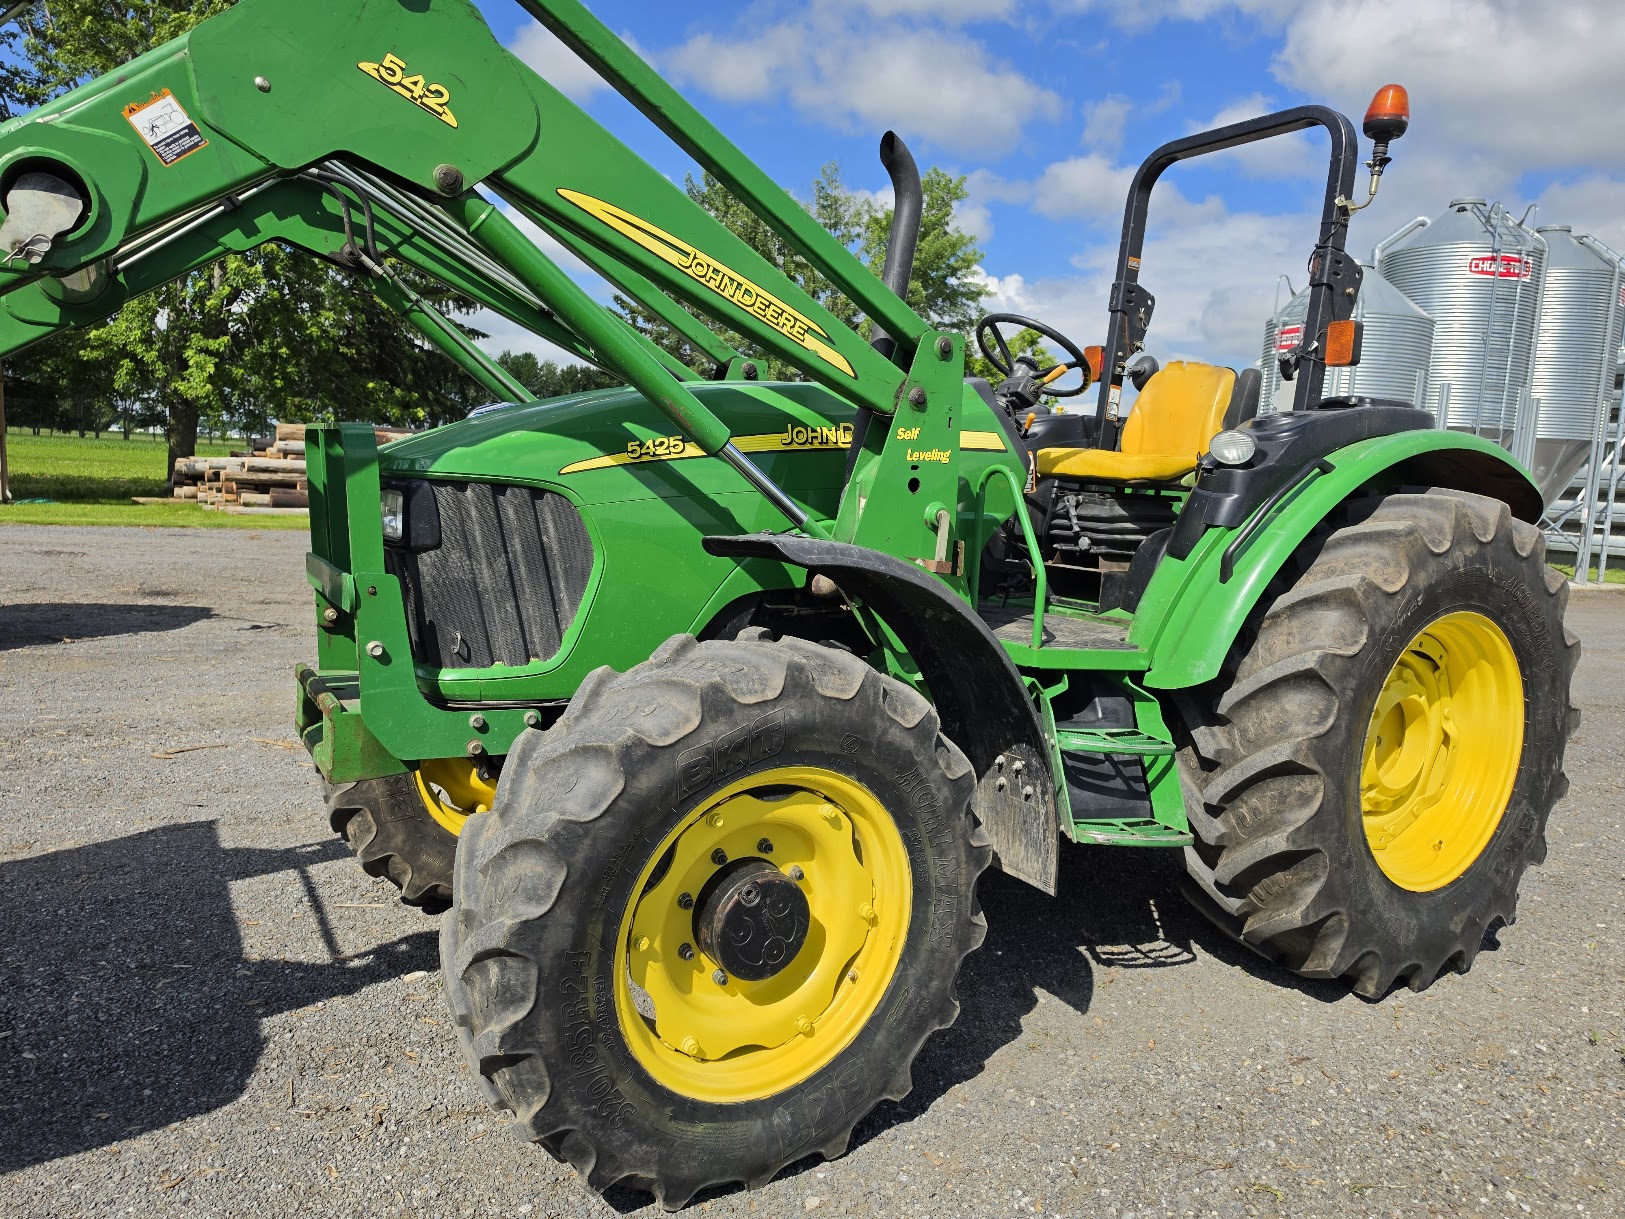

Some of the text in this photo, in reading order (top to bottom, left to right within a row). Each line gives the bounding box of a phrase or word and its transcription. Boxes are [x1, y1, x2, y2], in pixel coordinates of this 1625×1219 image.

[378, 52, 450, 117] 542
[627, 435, 686, 460] 5425
[896, 427, 920, 440] Self
[906, 448, 952, 464] Leveling
[677, 708, 786, 799] BKT
[893, 766, 958, 947] AGRI MAX
[560, 950, 637, 1129] 320/85R24
